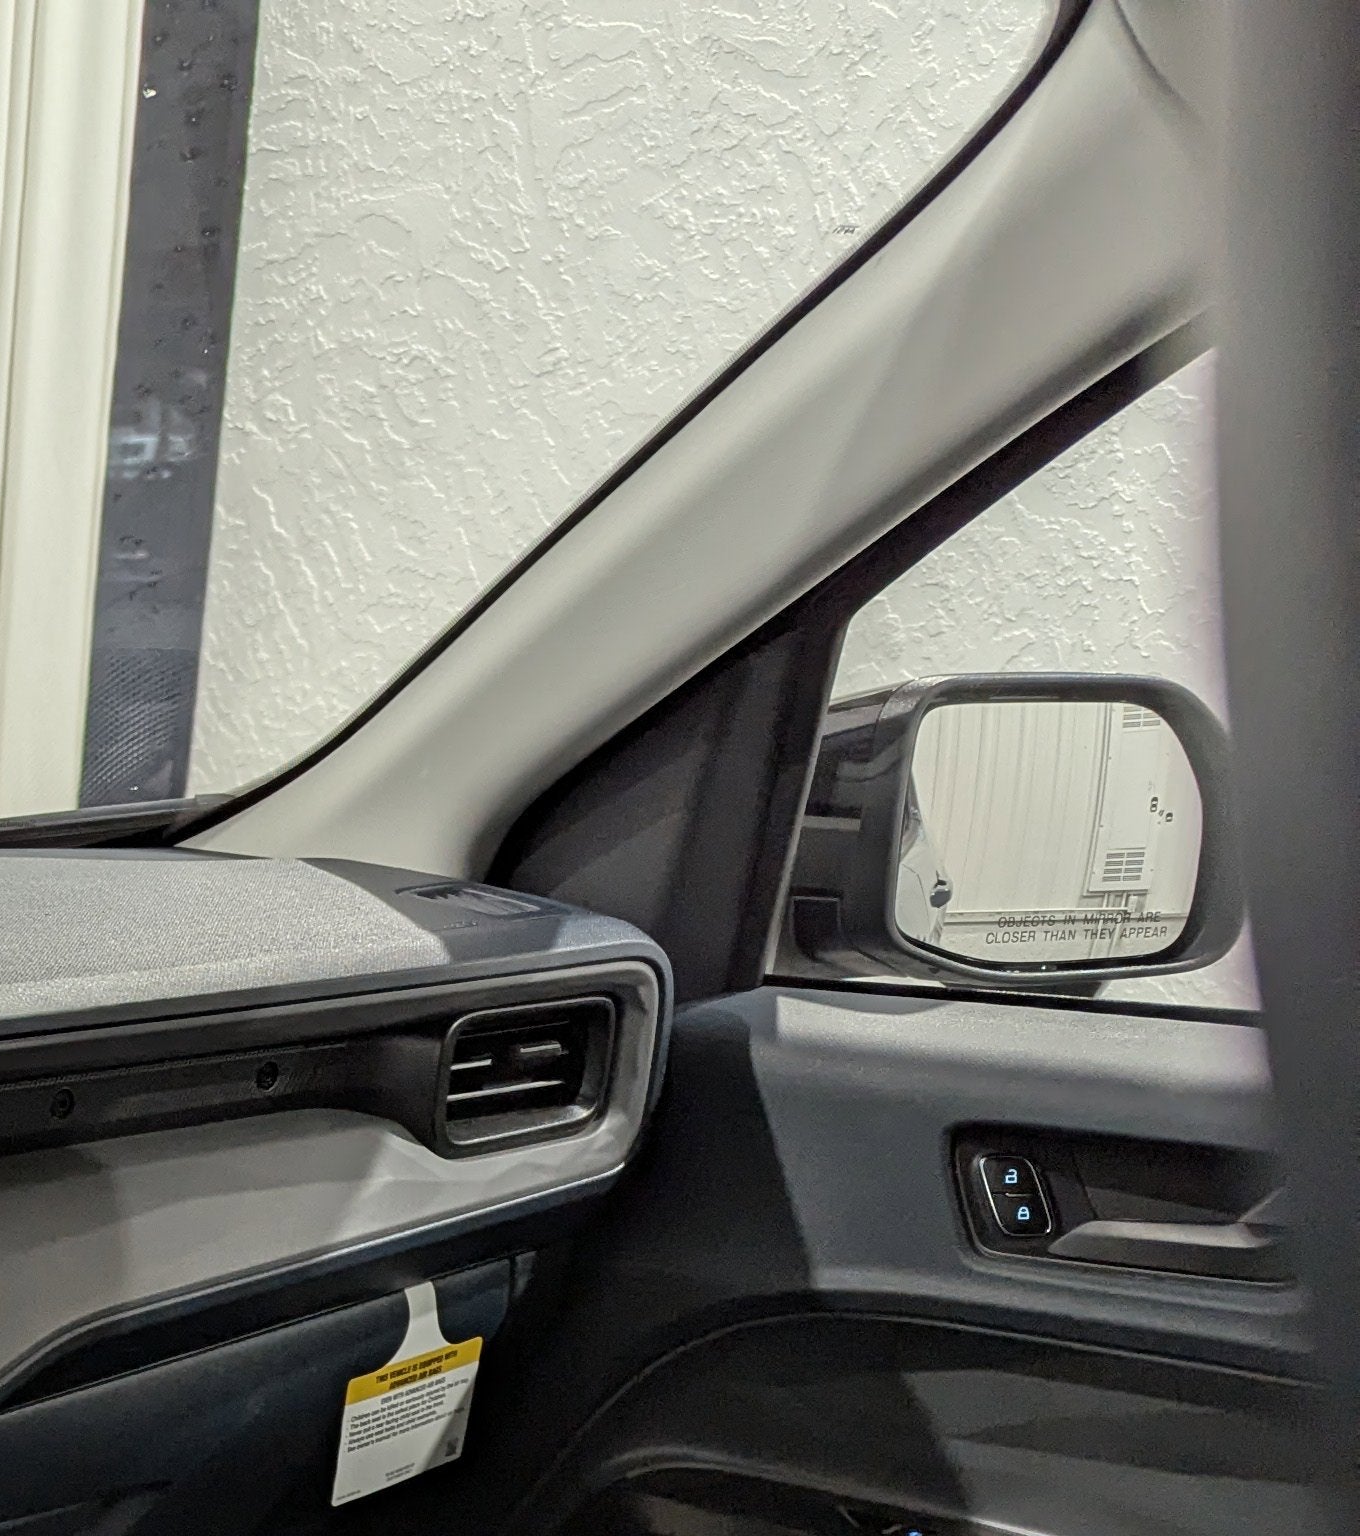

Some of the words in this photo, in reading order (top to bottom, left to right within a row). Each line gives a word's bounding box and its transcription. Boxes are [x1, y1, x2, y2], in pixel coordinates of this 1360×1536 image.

[997, 915, 1056, 928] OBJECTS
[1063, 915, 1076, 926] IN
[1082, 912, 1131, 925] MIRROR
[1137, 911, 1162, 924] ARE
[985, 932, 1036, 944] CLOSER
[1043, 930, 1076, 942] THAN
[1083, 927, 1116, 940] THEY
[1119, 926, 1168, 939] APPEAR
[376, 1373, 389, 1384] THIS
[389, 1365, 412, 1380] VEHICLE
[412, 1363, 418, 1372] IS
[418, 1354, 444, 1369] EQUIPPED
[444, 1350, 458, 1360] WITH
[419, 1370, 428, 1380] AIR
[428, 1365, 442, 1376] BAGS
